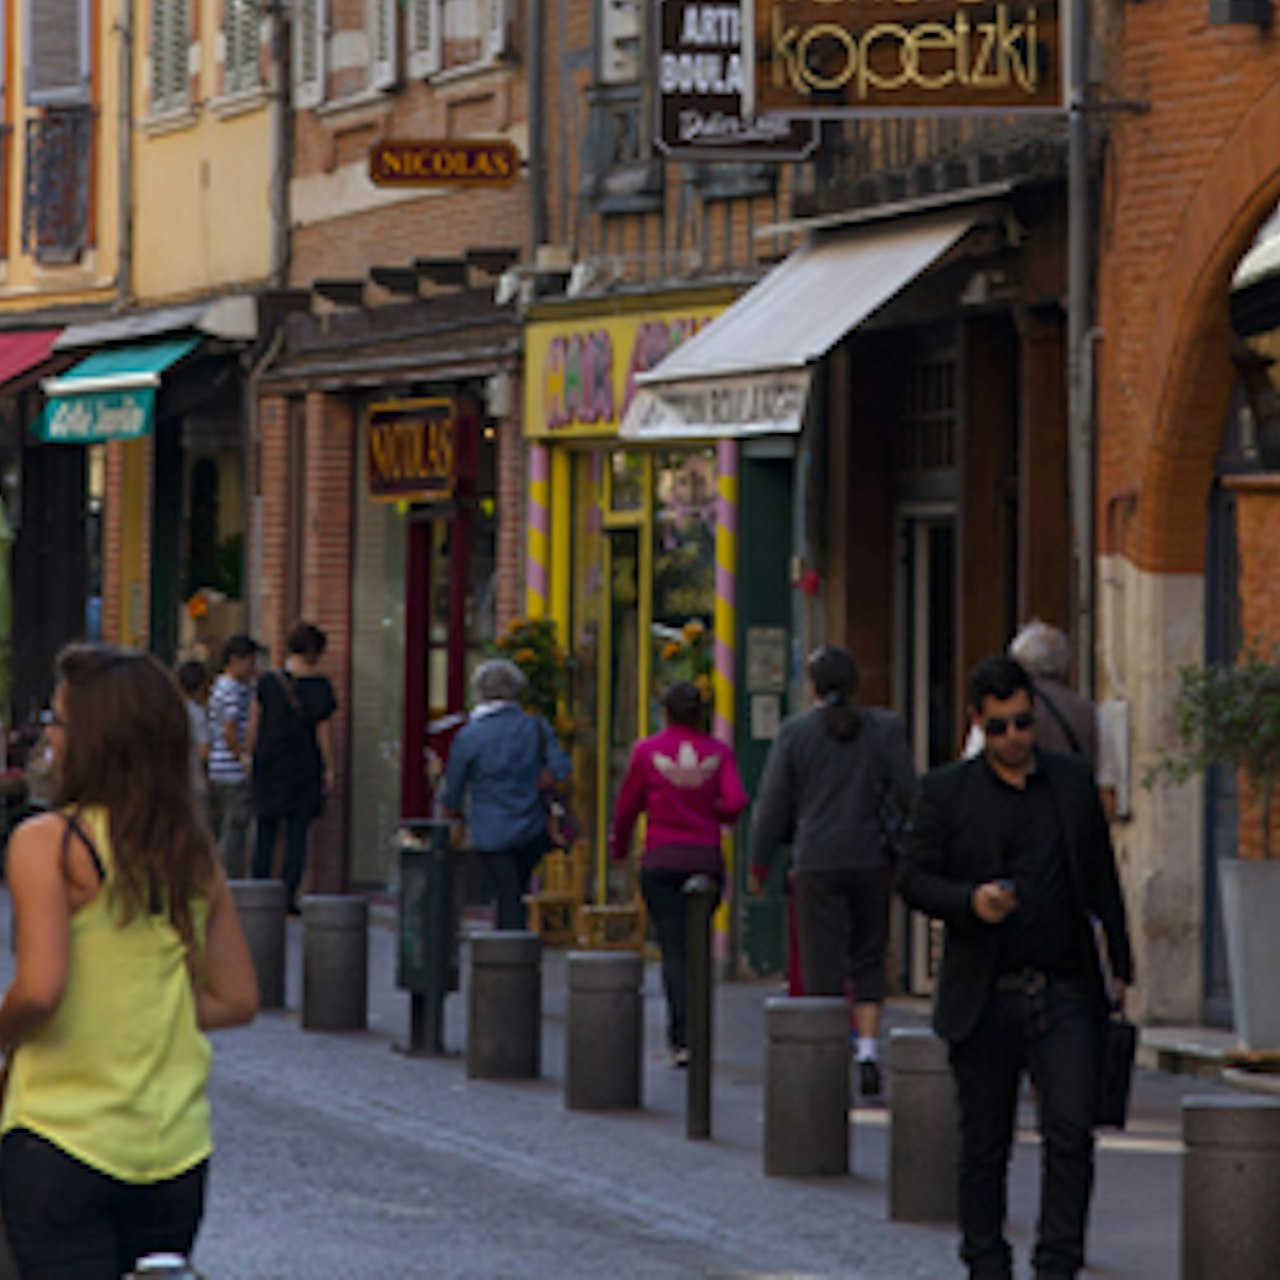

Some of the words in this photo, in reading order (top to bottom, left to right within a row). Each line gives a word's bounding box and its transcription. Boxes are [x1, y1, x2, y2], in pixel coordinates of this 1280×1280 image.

[769, 2, 1039, 100] kopetzki
[380, 148, 511, 178] NICOLAS
[371, 420, 454, 481] NICOLAS
